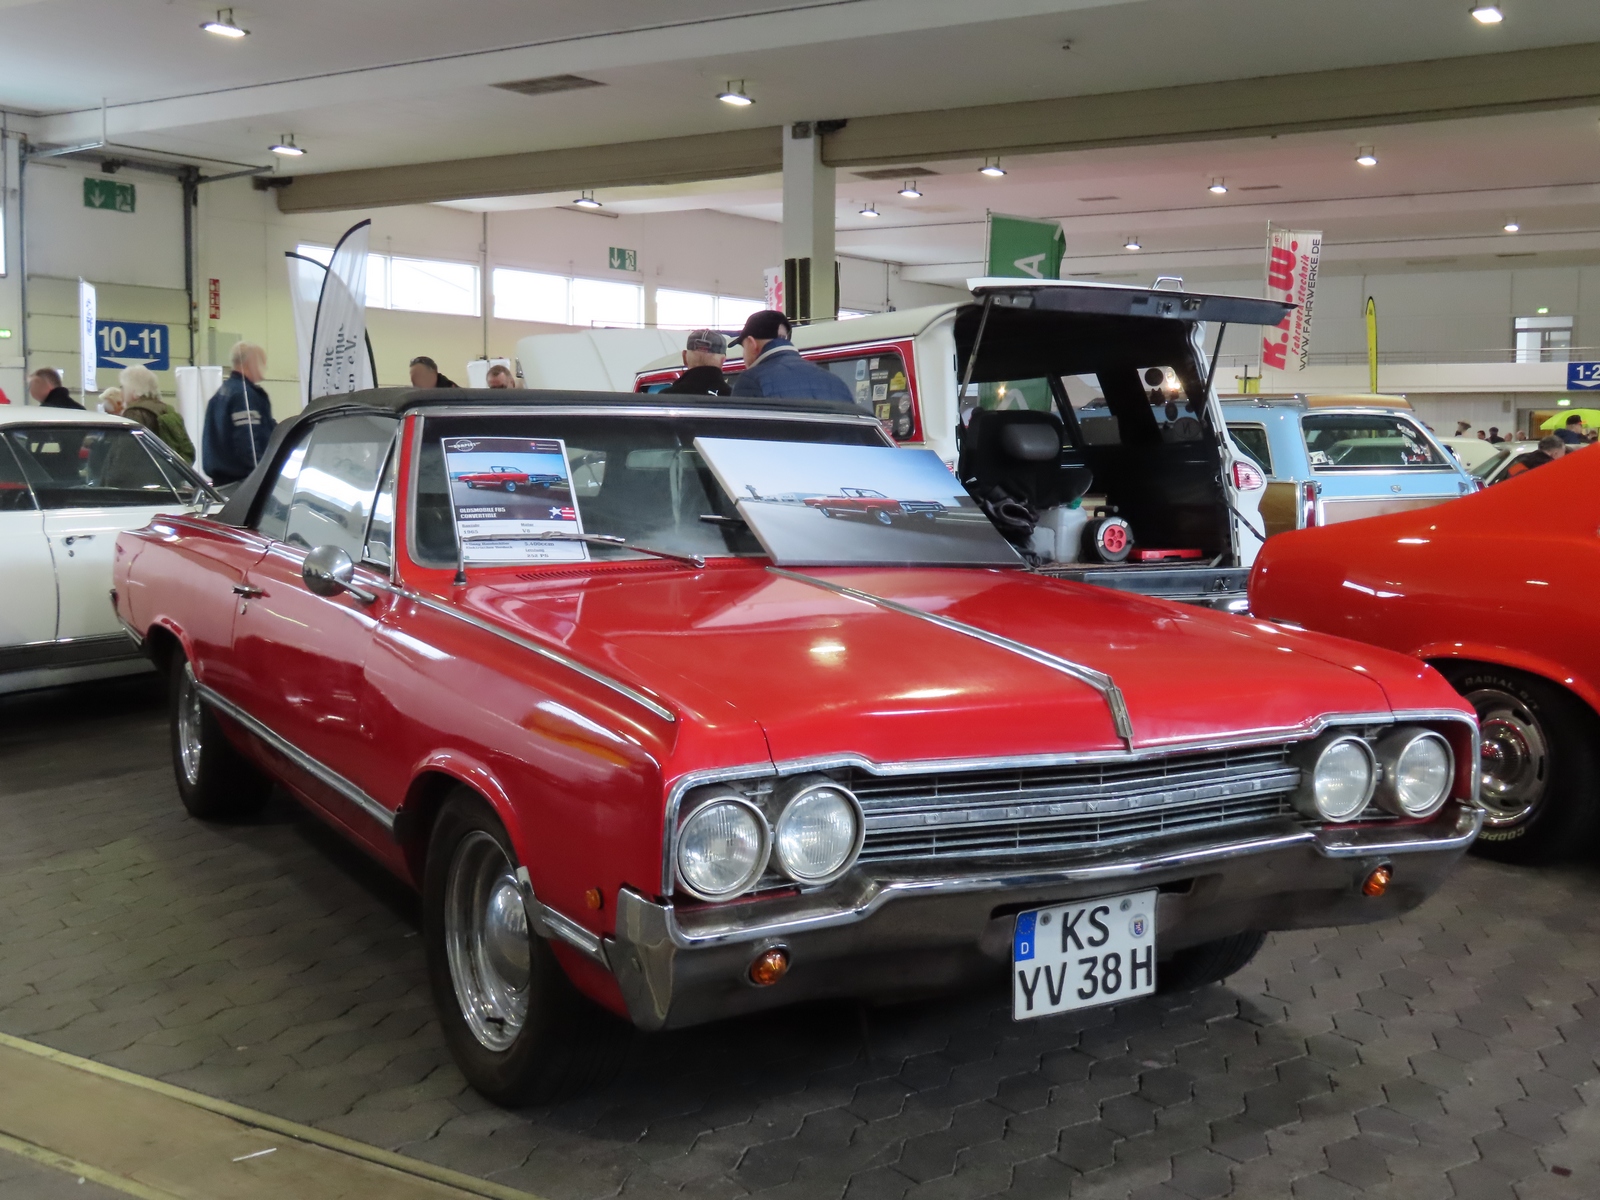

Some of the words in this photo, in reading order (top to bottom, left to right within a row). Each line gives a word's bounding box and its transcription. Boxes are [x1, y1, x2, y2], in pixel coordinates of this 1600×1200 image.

[1299, 239, 1320, 371] WWW.FAHRWERKE.DE
[98, 326, 161, 354] 10-11
[1465, 676, 1515, 691] RADIAL
[1480, 826, 1525, 841] COOPE
[1061, 905, 1111, 953] KS
[1020, 942, 1029, 955] D
[1018, 961, 1067, 1011] YV
